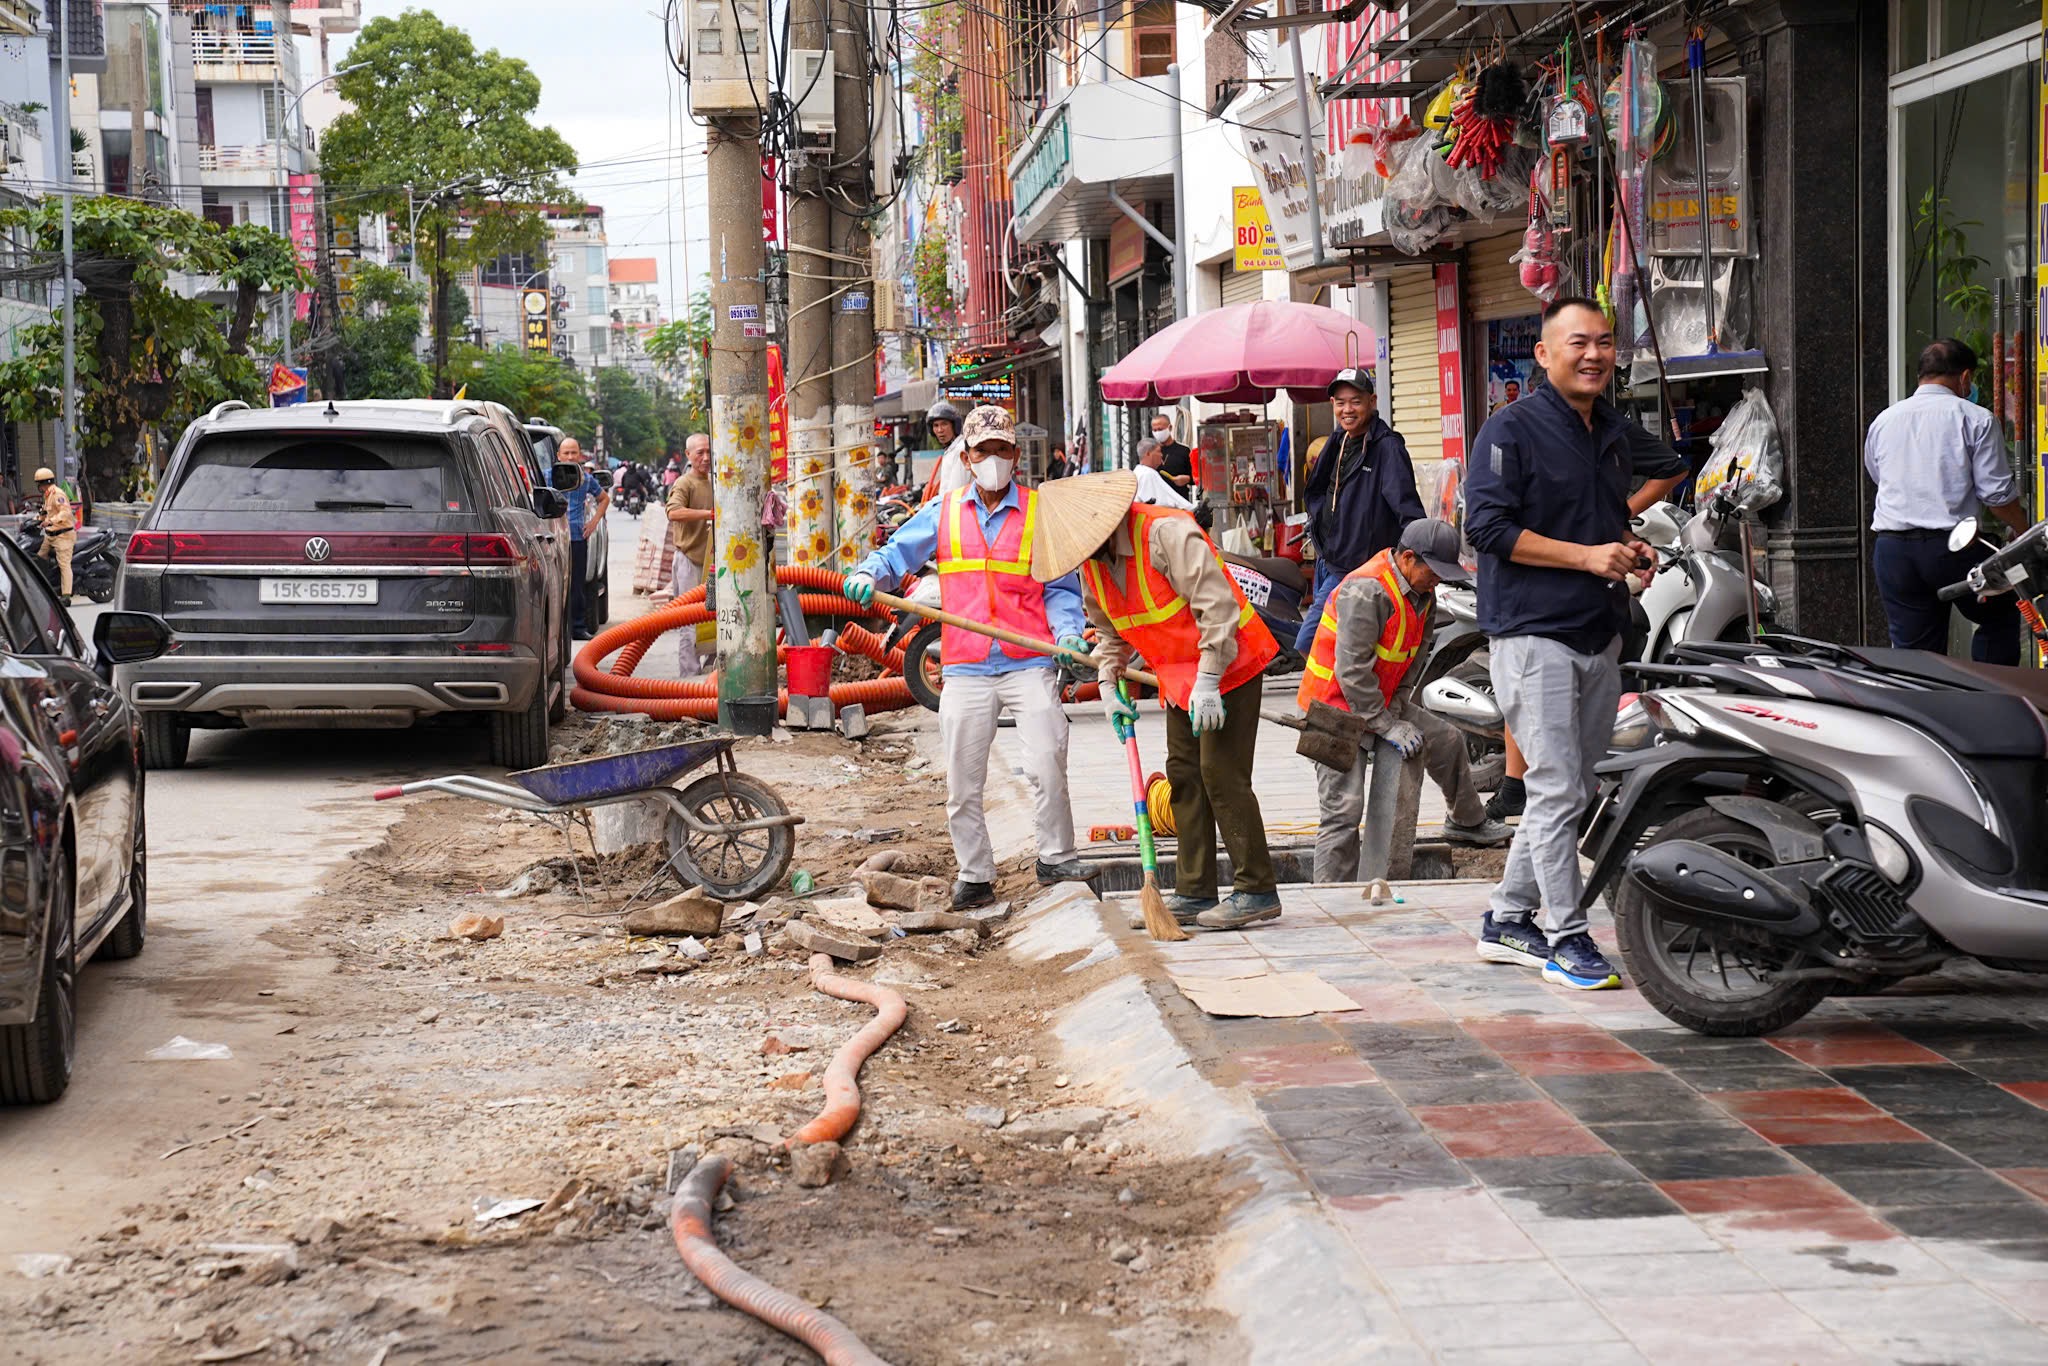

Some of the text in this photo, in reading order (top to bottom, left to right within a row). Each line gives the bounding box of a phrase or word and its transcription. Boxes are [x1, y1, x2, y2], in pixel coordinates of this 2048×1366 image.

[272, 582, 367, 598] 15K-665.79
[1785, 718, 1818, 730] mode
[1499, 934, 1530, 953] HOKA
